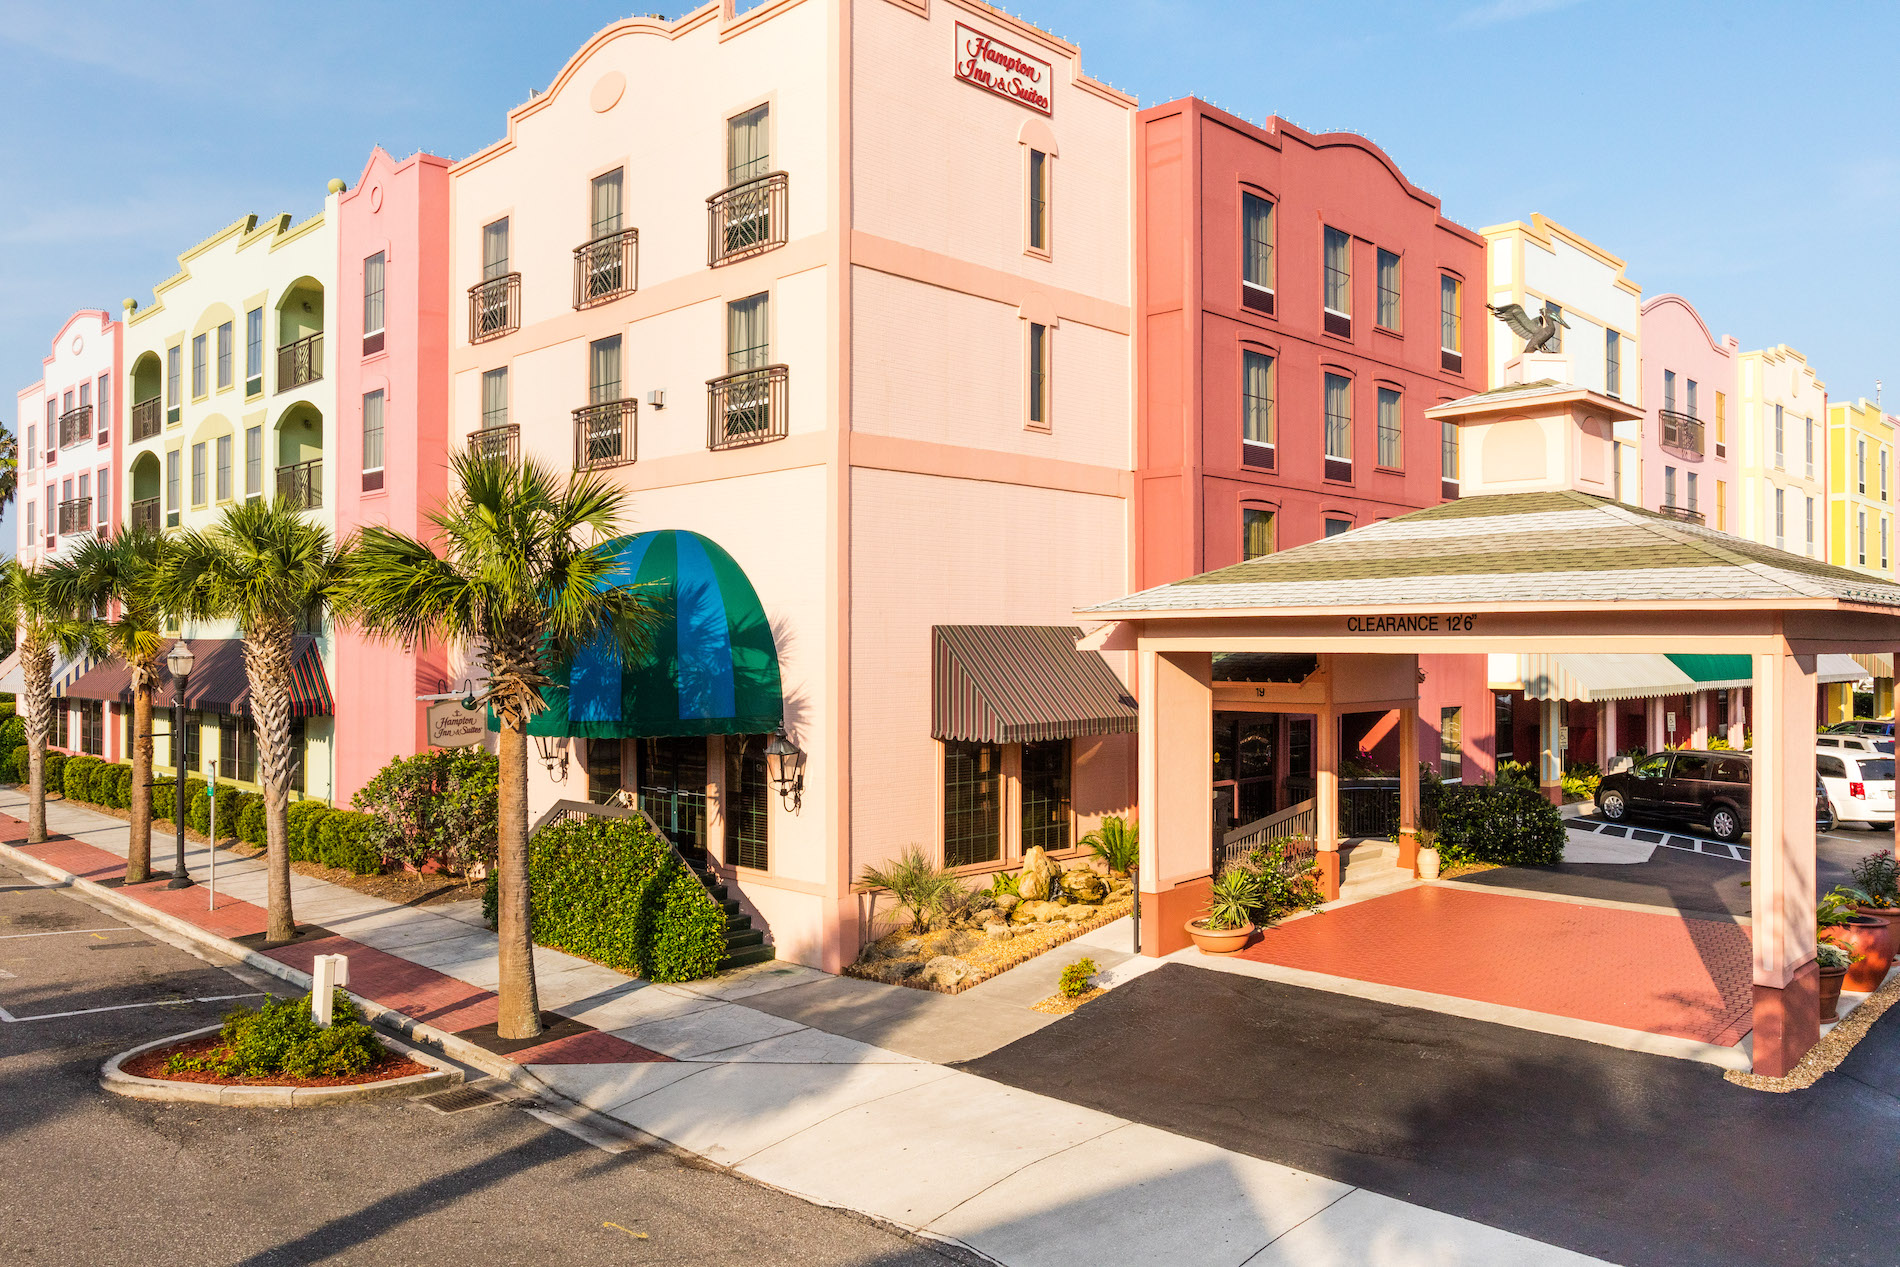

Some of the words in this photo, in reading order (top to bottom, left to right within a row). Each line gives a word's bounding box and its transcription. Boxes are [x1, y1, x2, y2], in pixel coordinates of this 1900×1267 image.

[966, 37, 1041, 82] Hampton
[958, 58, 997, 88] Inn
[997, 77, 1008, 93] &
[1007, 77, 1048, 109] Suites
[1347, 616, 1439, 632] CLEARANCE
[1446, 614, 1477, 631] 12'6"
[435, 717, 477, 729] Hampton
[434, 728, 454, 739] Inn
[460, 726, 481, 735] Suites
